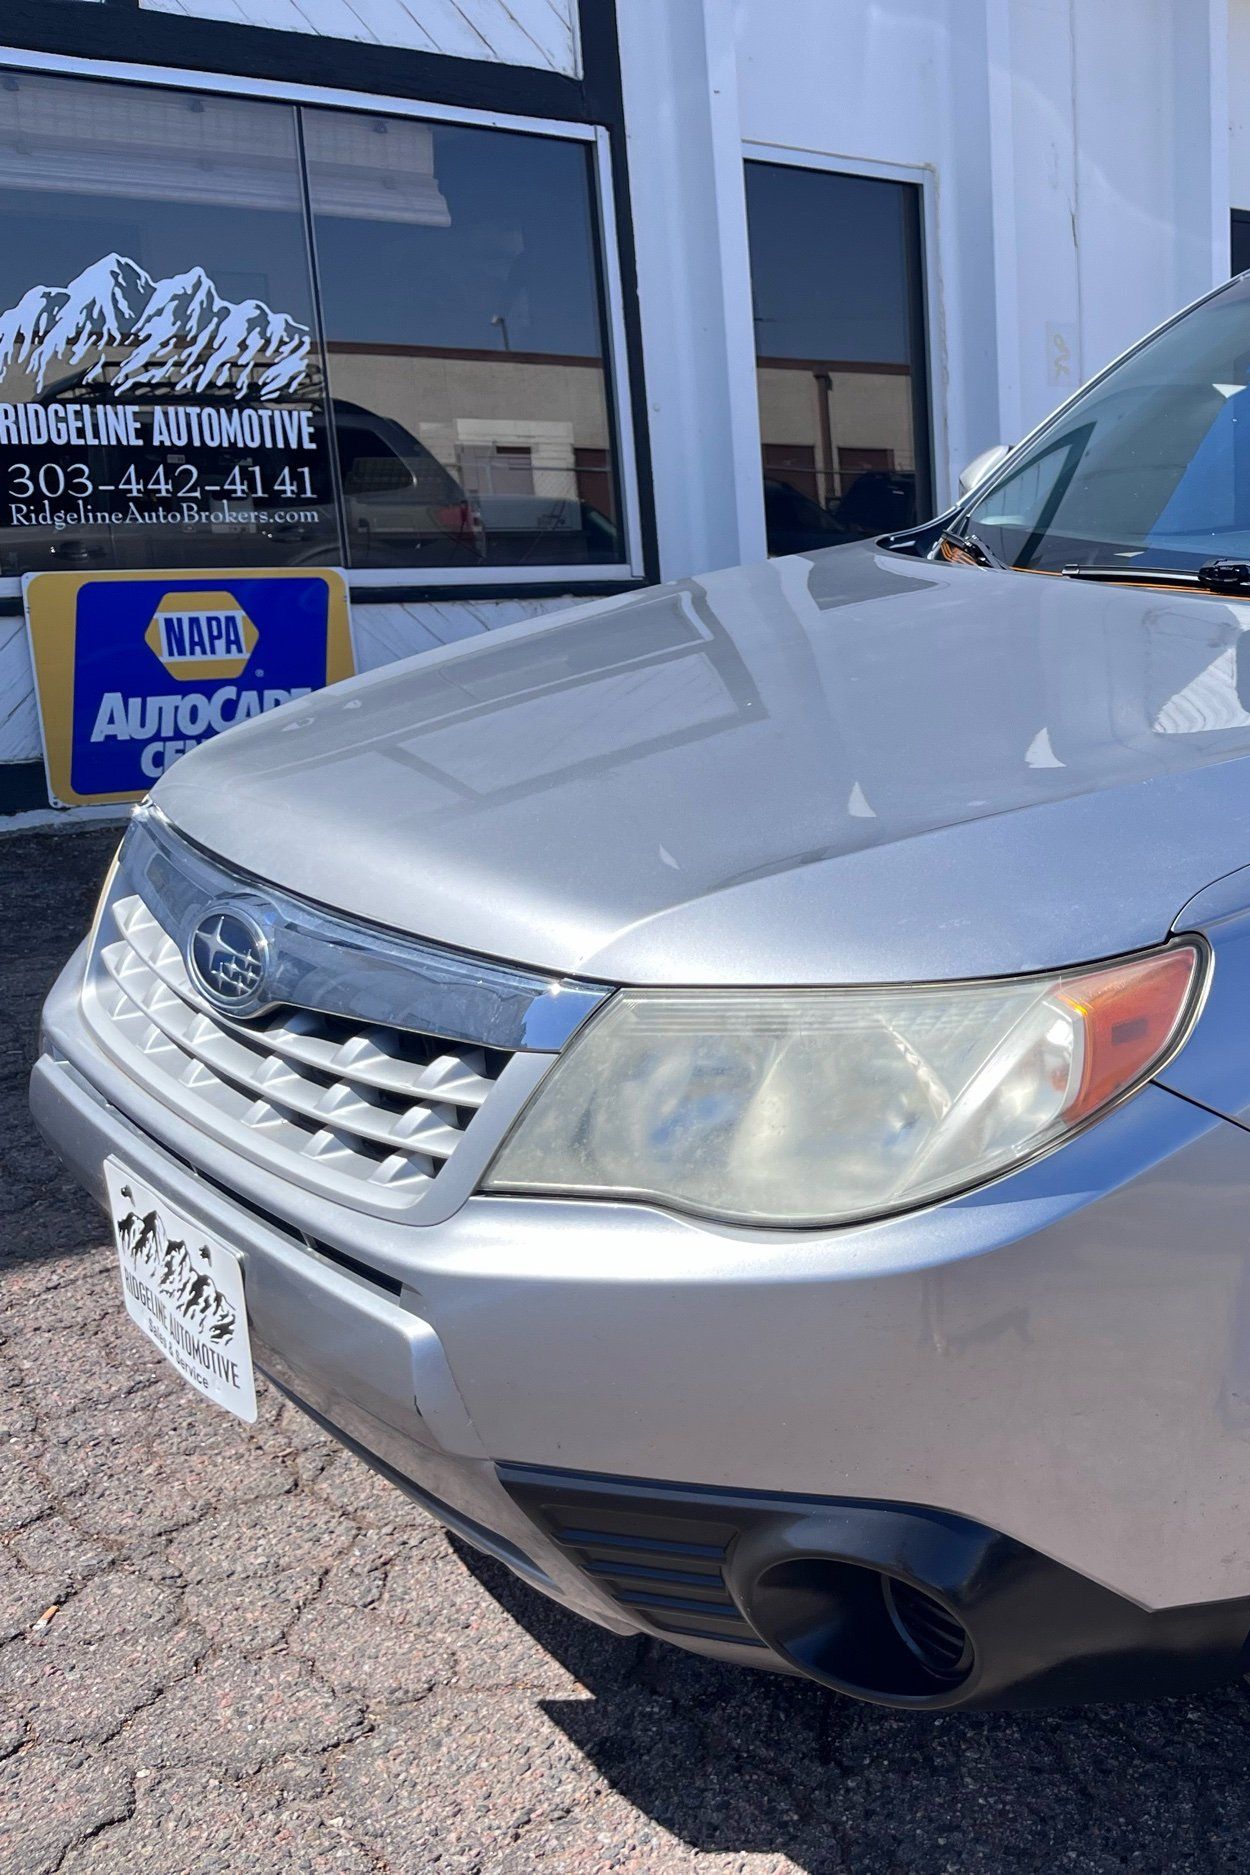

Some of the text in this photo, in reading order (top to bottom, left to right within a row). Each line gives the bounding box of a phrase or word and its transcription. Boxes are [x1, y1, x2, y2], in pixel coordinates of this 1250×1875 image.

[0, 403, 317, 449] RIDGELINE AUTOMOTIVE
[8, 463, 318, 498] 303-442-4141
[11, 500, 319, 529] RidgelineAutoBrokers.com
[164, 615, 244, 657] NAPA
[124, 1266, 240, 1389] RIDGELINE AUTOMOTIVE
[176, 1349, 208, 1389] Service
